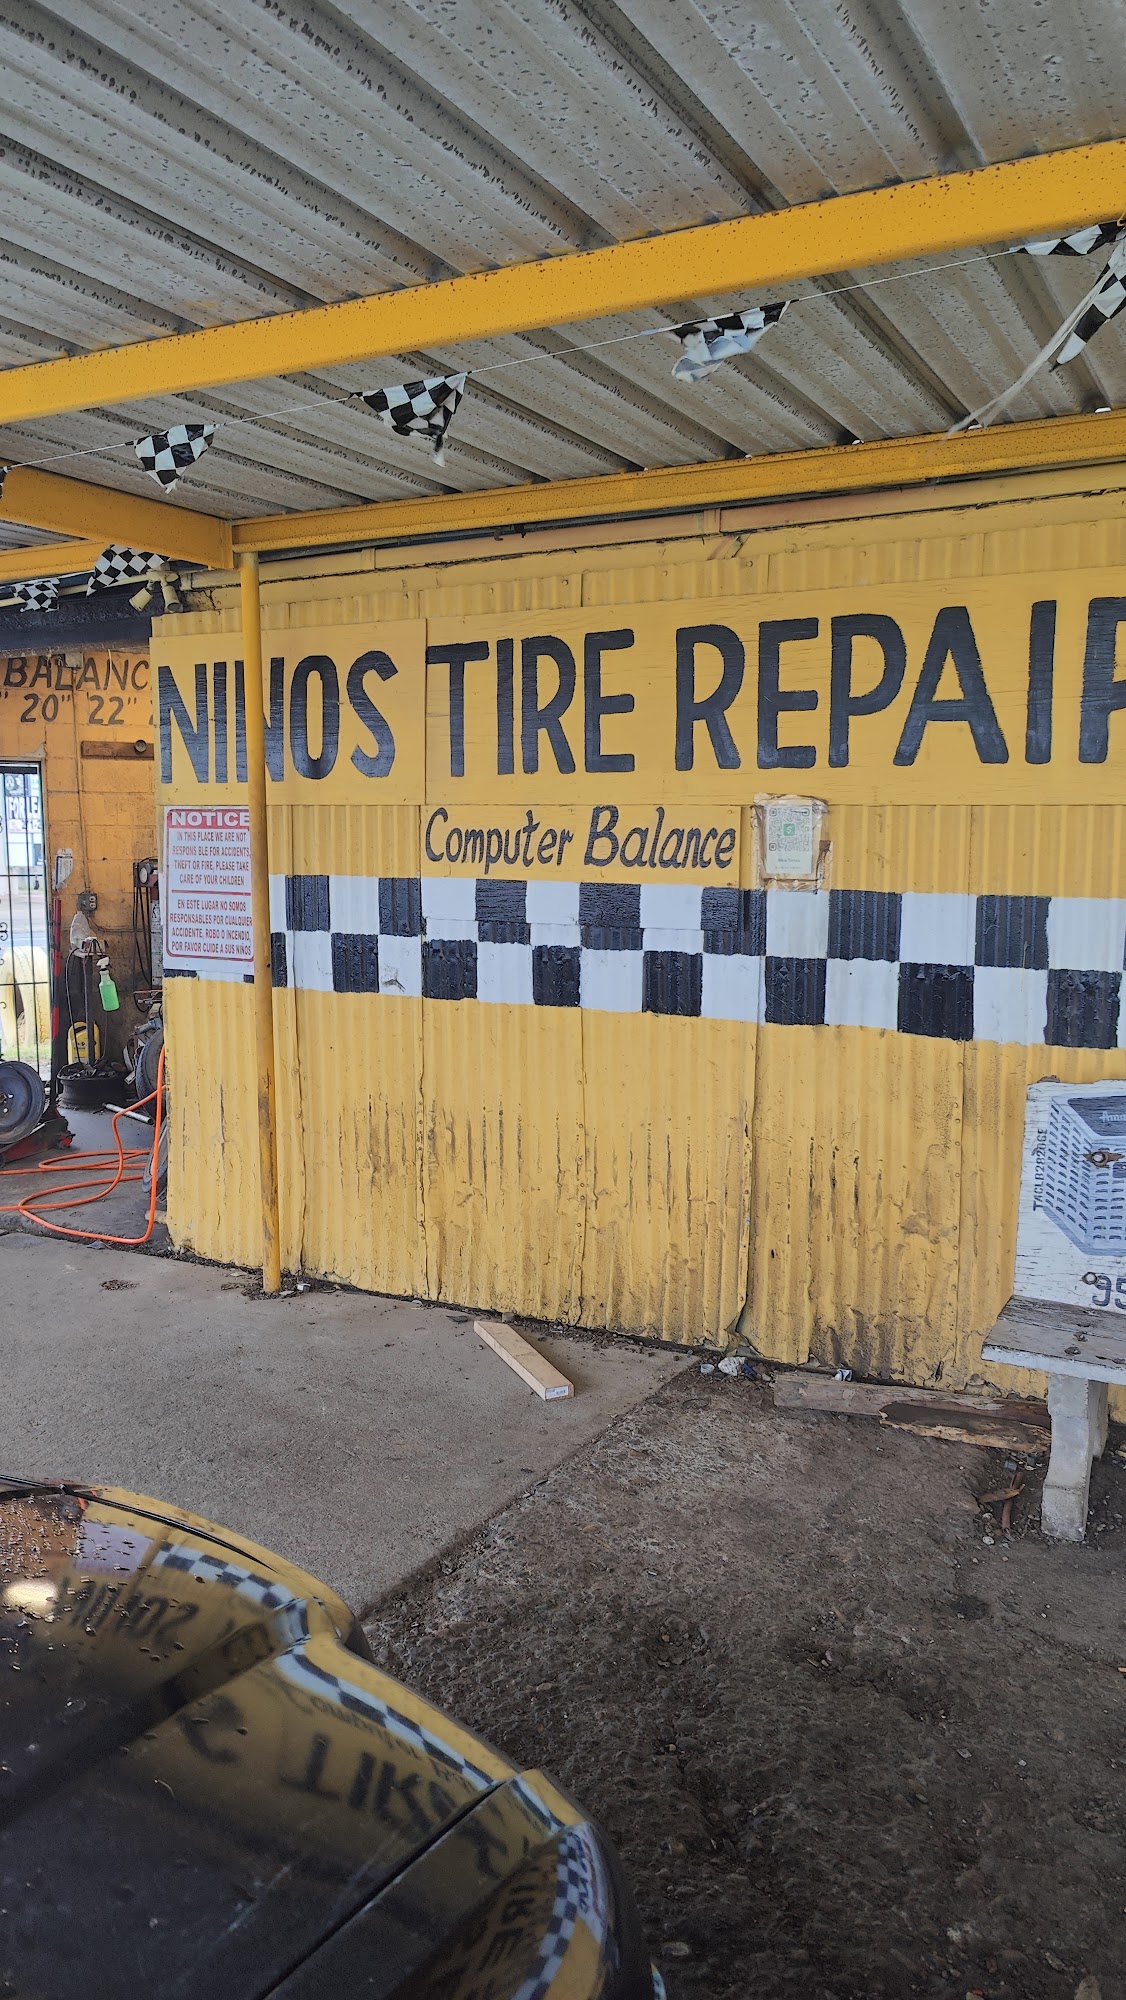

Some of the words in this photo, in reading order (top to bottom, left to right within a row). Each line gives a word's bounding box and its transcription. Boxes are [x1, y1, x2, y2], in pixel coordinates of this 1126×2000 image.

[20, 693, 71, 723] 20"
[88, 695, 137, 725] 22"
[158, 651, 398, 784] NINOS
[425, 629, 635, 778] TIRE
[171, 811, 249, 827] NOTICE
[184, 831, 197, 842] THIS
[197, 831, 214, 842] PLACE
[215, 832, 223, 842] WE
[225, 832, 235, 842] ARE
[236, 832, 247, 843] NOT
[425, 806, 574, 875] Computer
[584, 804, 736, 869] Balance
[209, 846, 220, 857] FOR
[174, 859, 191, 870] THEFT
[192, 860, 201, 870] OR
[216, 861, 235, 871] PLEASE
[236, 861, 249, 872] TAKE
[179, 873, 194, 884] CARE
[195, 874, 203, 884] OF
[203, 874, 219, 885] YOUR
[219, 875, 245, 886] CHILDREN
[177, 899, 185, 909] EN
[186, 899, 200, 910] ESTE
[201, 900, 219, 911] LUGAR
[220, 901, 228, 911] NO
[228, 901, 247, 912] SOMOS
[170, 912, 212, 925] RESPONSABLES
[213, 914, 224, 925] POR
[224, 915, 253, 927] CUALQUIER
[205, 928, 220, 939] ROBO
[221, 929, 226, 939] O
[171, 941, 183, 952] POR
[184, 941, 202, 953] FAVOR
[202, 943, 219, 954] CUIDE
[220, 943, 224, 954] A
[224, 944, 235, 955] SUS
